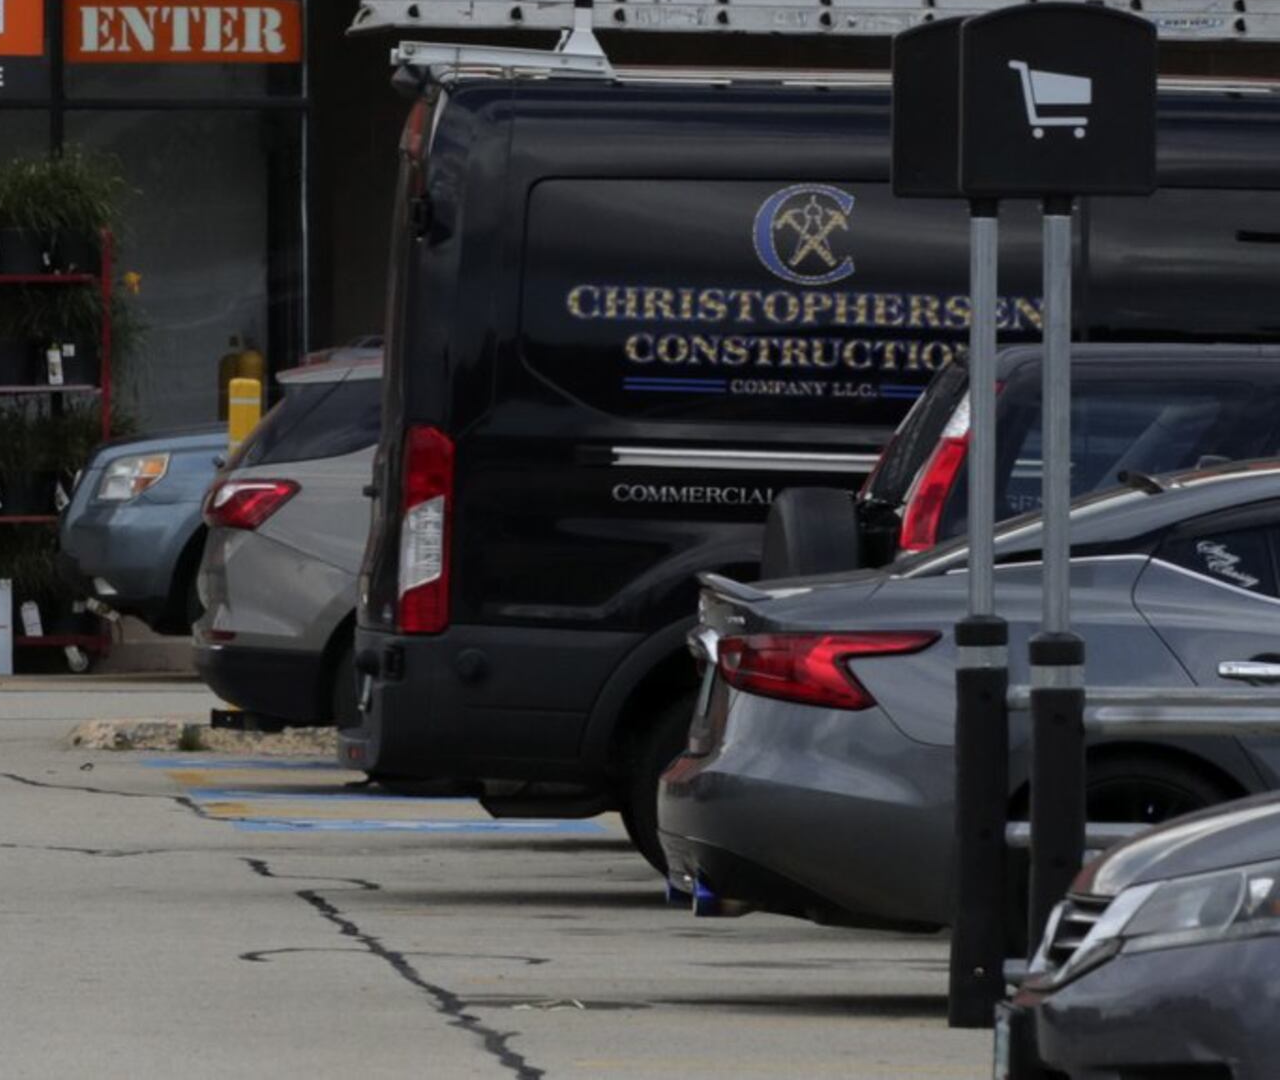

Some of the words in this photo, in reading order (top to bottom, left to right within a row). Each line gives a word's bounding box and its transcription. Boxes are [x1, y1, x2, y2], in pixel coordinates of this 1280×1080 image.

[79, 6, 287, 53] ENTER
[624, 332, 969, 374] CONSTRUCTIO
[729, 379, 827, 398] COMPANY
[832, 381, 877, 399] LLC.
